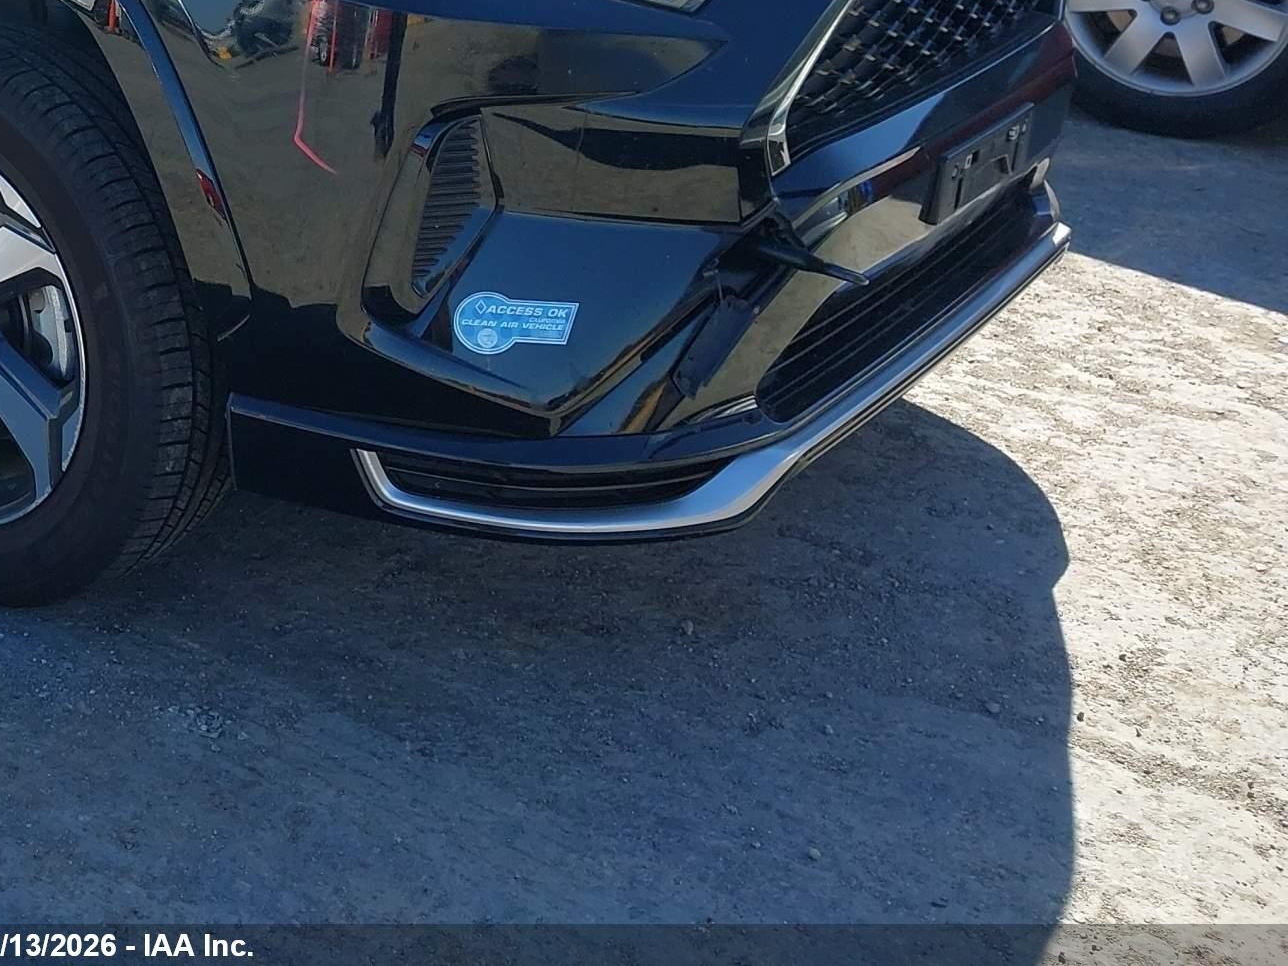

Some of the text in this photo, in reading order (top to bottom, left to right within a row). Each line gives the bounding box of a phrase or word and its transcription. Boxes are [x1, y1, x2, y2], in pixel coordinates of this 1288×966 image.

[486, 305, 568, 318] ACCESS OK
[461, 319, 565, 331] CLEAN AIR VEHICLE
